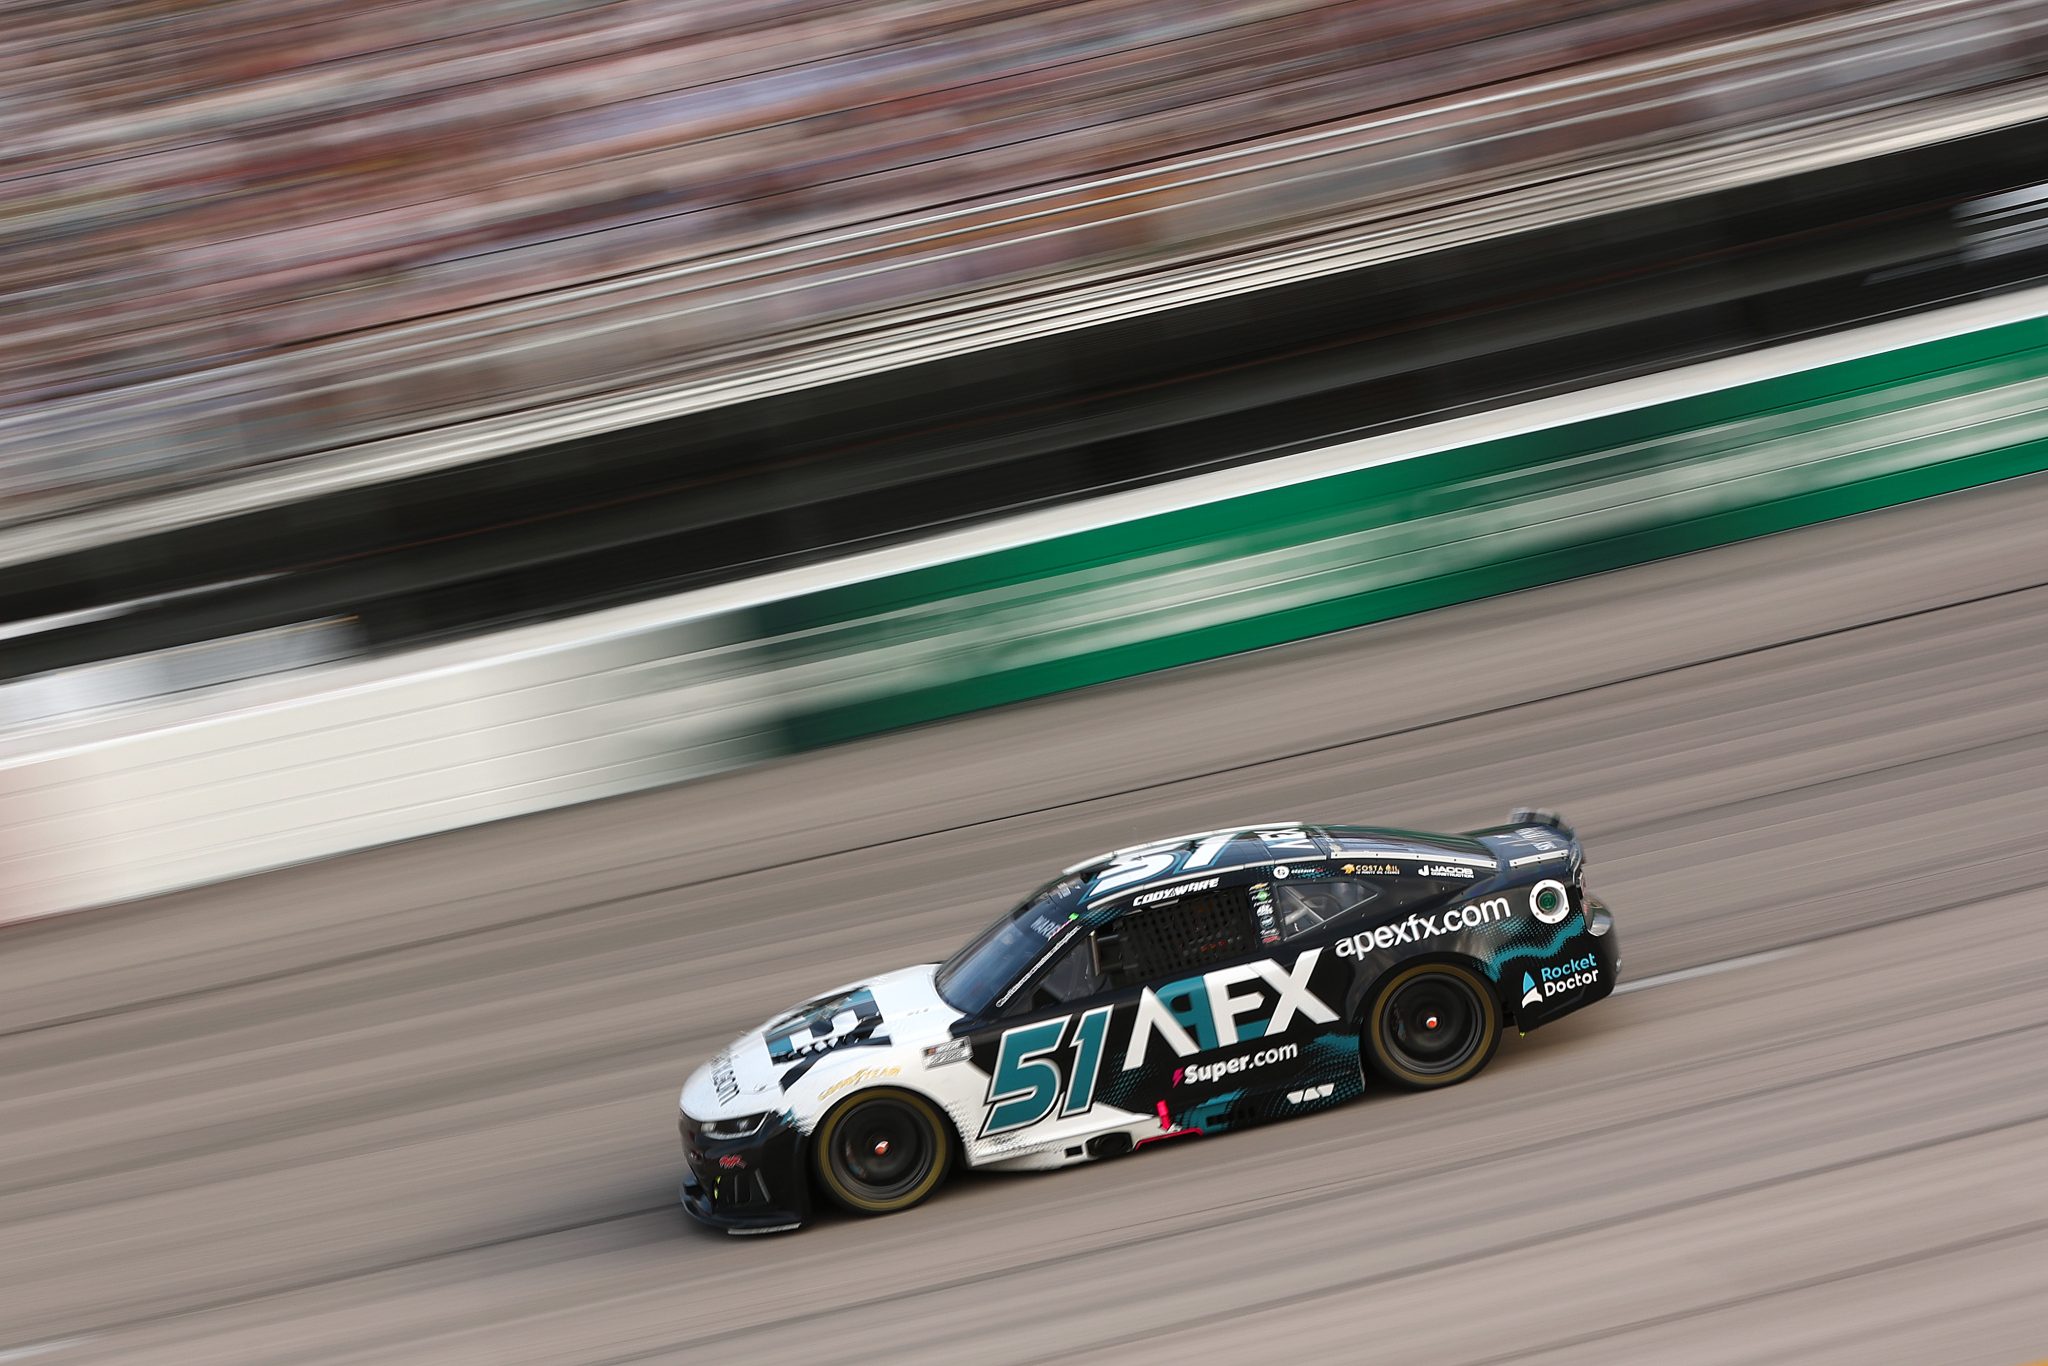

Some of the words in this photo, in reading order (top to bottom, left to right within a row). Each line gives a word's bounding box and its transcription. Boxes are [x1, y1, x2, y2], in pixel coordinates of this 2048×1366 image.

[1355, 864, 1384, 872] COSTA
[1430, 865, 1474, 875] JACOB
[1132, 888, 1175, 907] CODY
[1173, 877, 1220, 896] WARE
[1335, 897, 1512, 961] apexfx.com
[1541, 953, 1598, 982] Rocket
[1544, 969, 1600, 997] Doctor
[977, 1004, 1114, 1140] 51
[1184, 1042, 1299, 1084] Super.com
